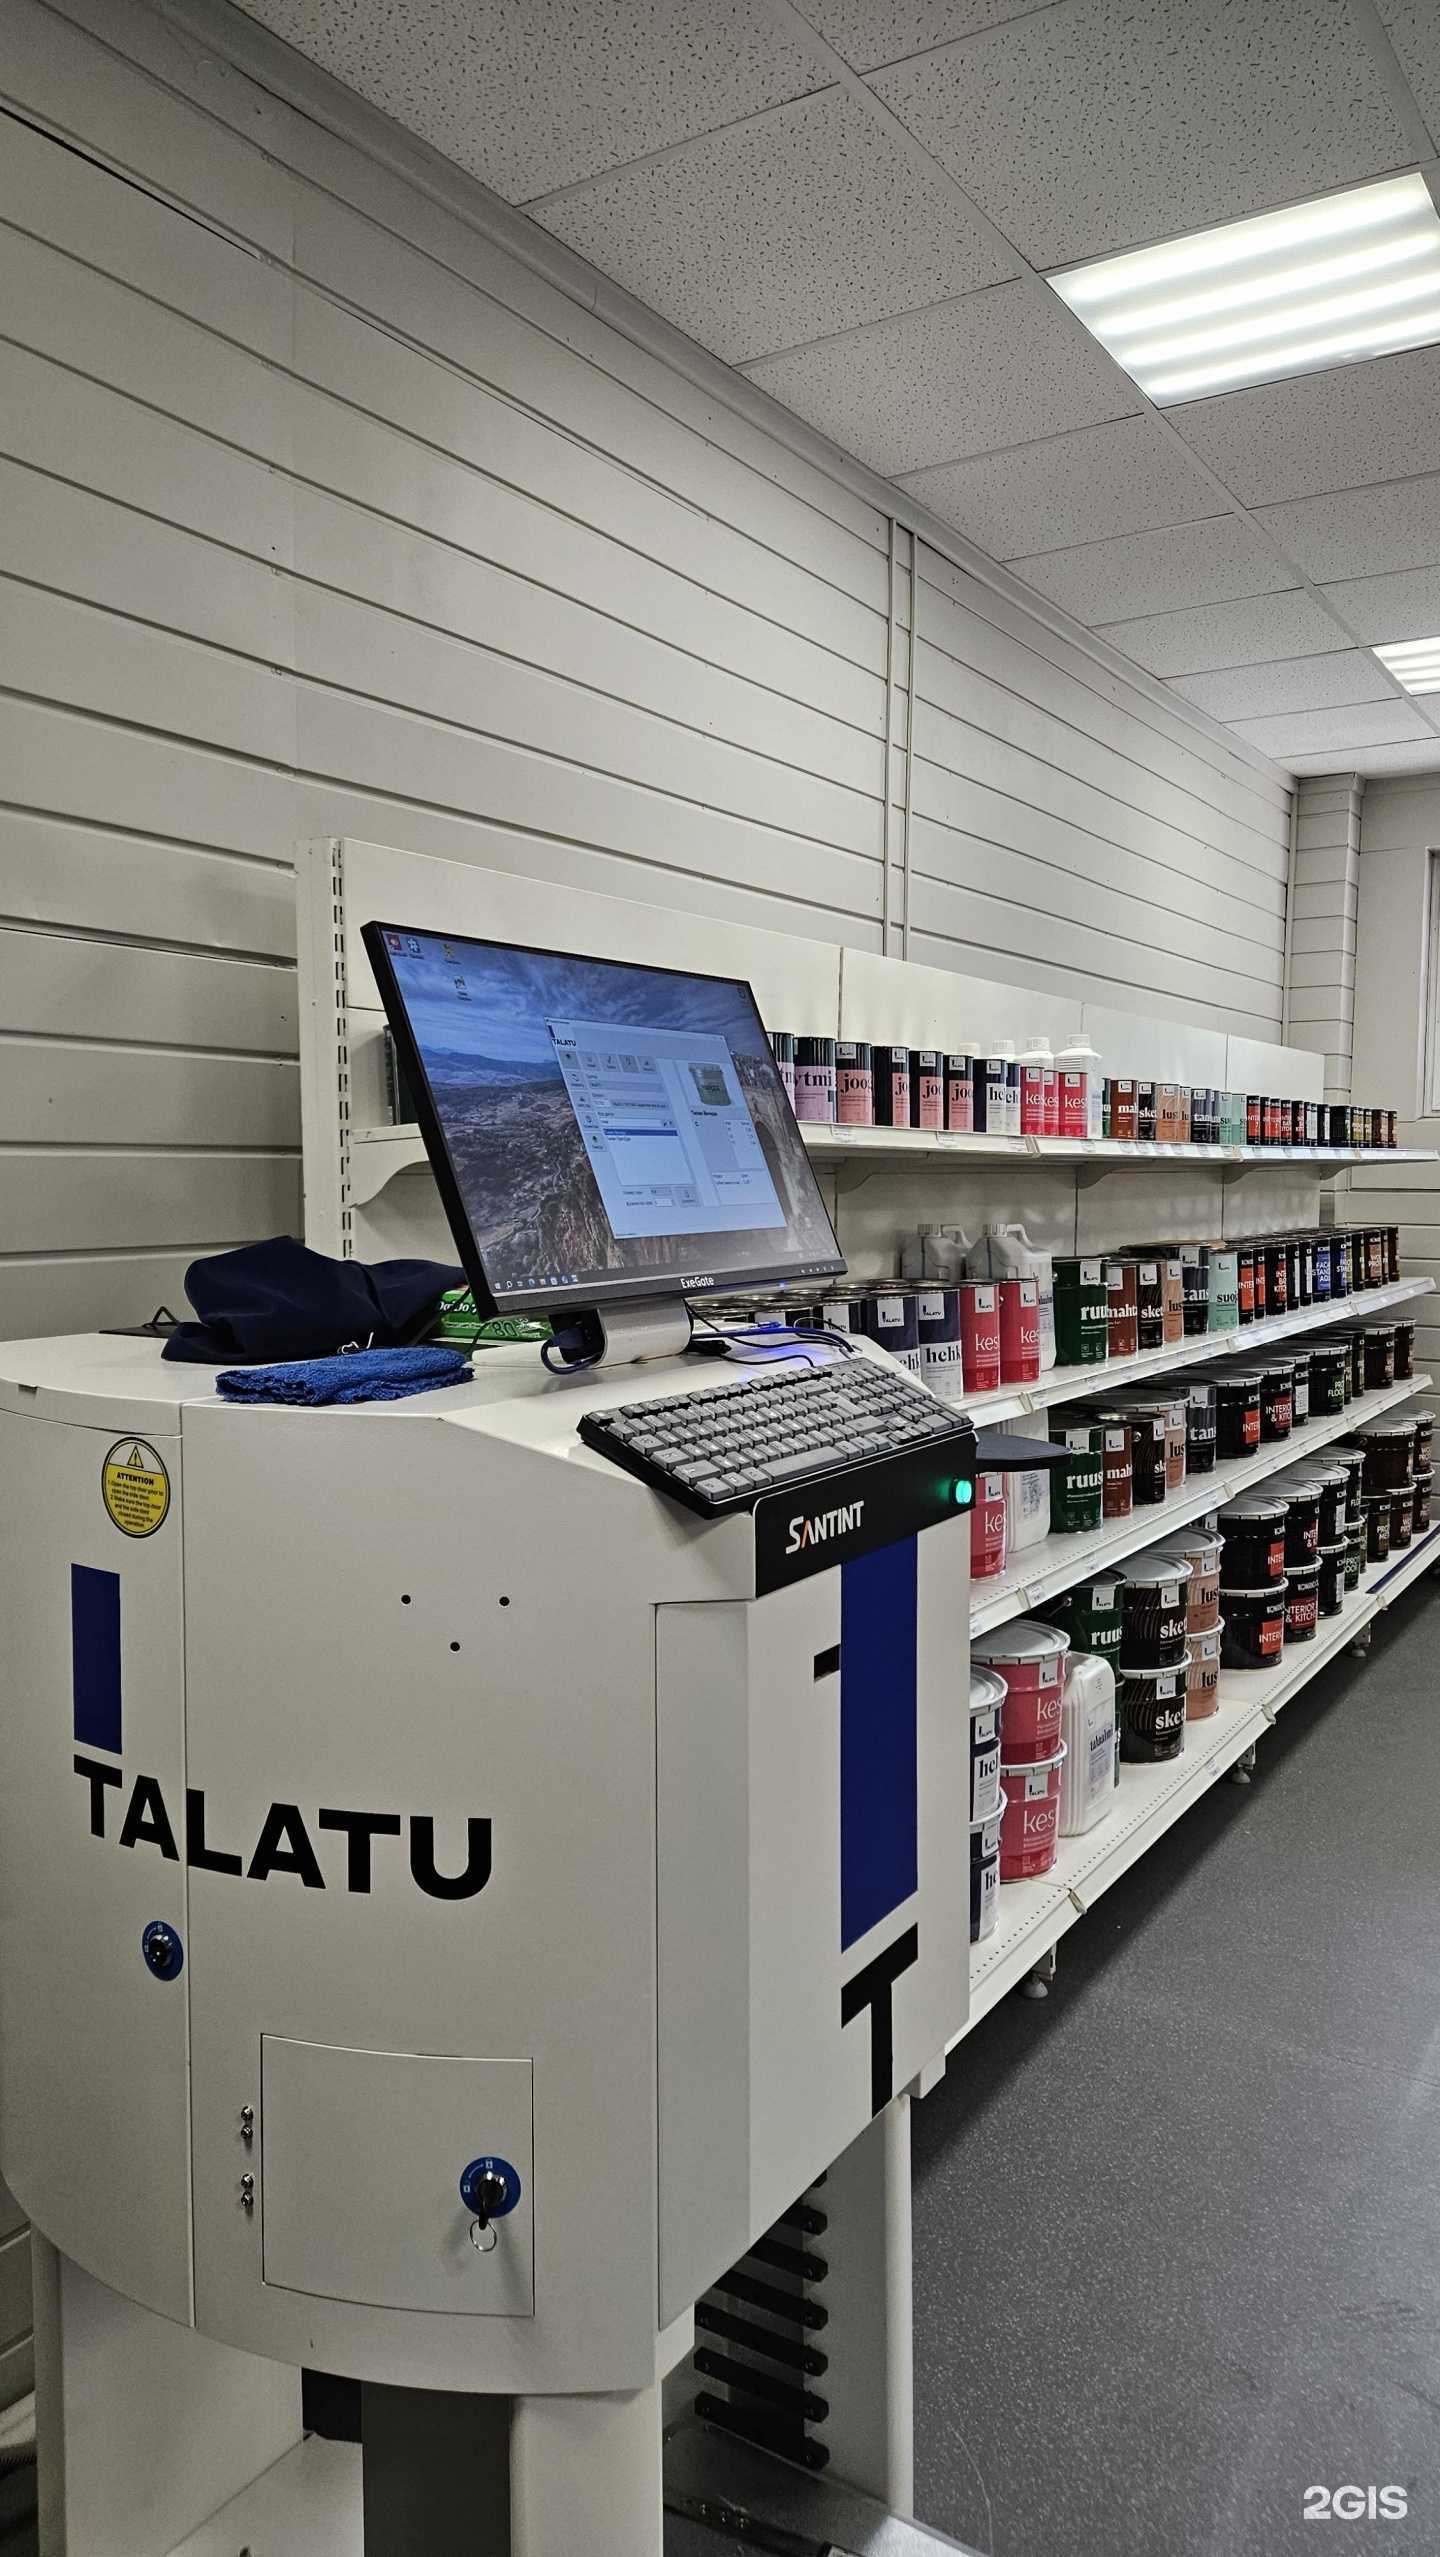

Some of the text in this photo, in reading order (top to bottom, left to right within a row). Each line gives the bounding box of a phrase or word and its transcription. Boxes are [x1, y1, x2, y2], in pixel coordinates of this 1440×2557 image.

[116, 1472, 154, 1486] ATTENTION
[785, 1500, 865, 1555] SANTINT
[1285, 1614, 1293, 1623] &
[73, 1754, 493, 1901] TALATU
